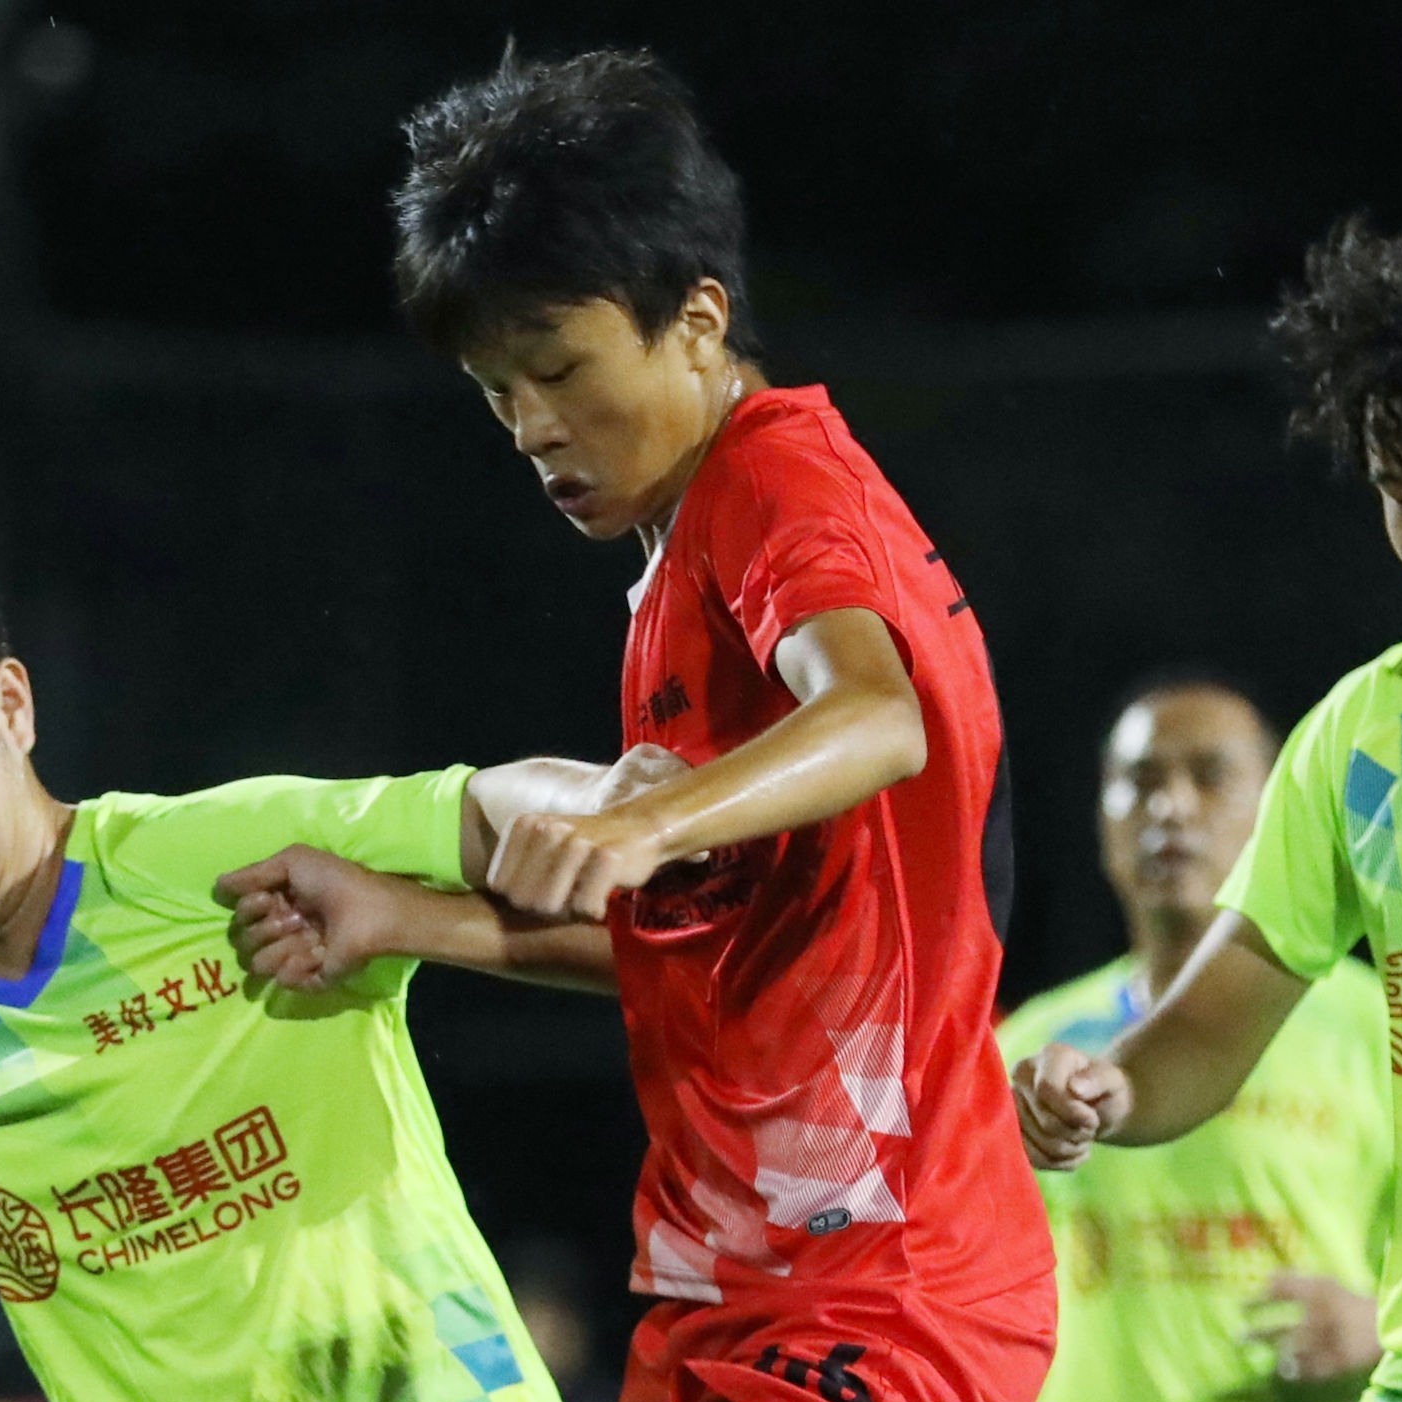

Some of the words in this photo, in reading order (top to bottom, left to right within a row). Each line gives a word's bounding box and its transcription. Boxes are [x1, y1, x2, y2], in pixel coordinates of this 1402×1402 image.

[82, 957, 238, 1055] 美好文化
[50, 1105, 288, 1241] 长隆集团
[76, 1171, 302, 1276] CHIMELONG
